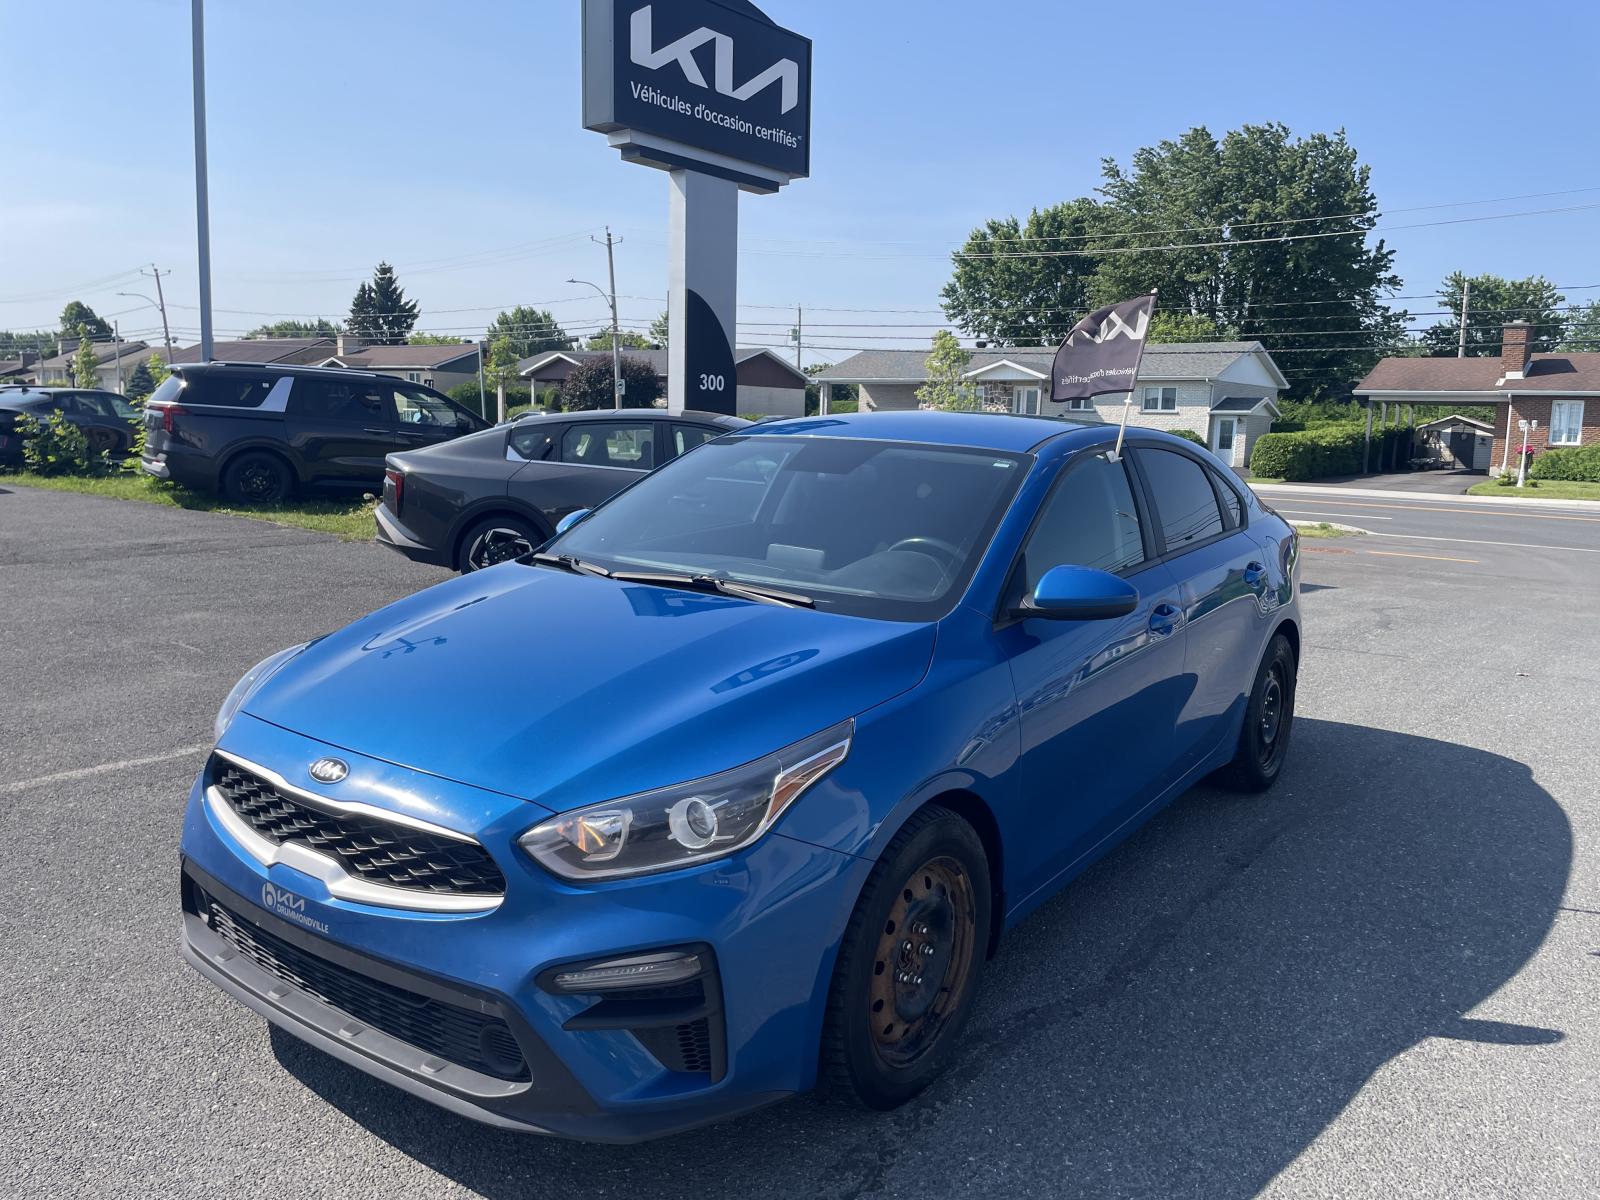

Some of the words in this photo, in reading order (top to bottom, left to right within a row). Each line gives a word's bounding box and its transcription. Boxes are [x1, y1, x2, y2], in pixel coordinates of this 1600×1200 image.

[630, 4, 799, 115] KIA
[630, 80, 692, 115] Véhicules
[694, 103, 753, 135] d'occasion
[755, 126, 797, 148] certifiés
[700, 373, 725, 391] 300
[277, 889, 305, 912] KIA
[277, 903, 329, 934] DRUMMONDVILLE
